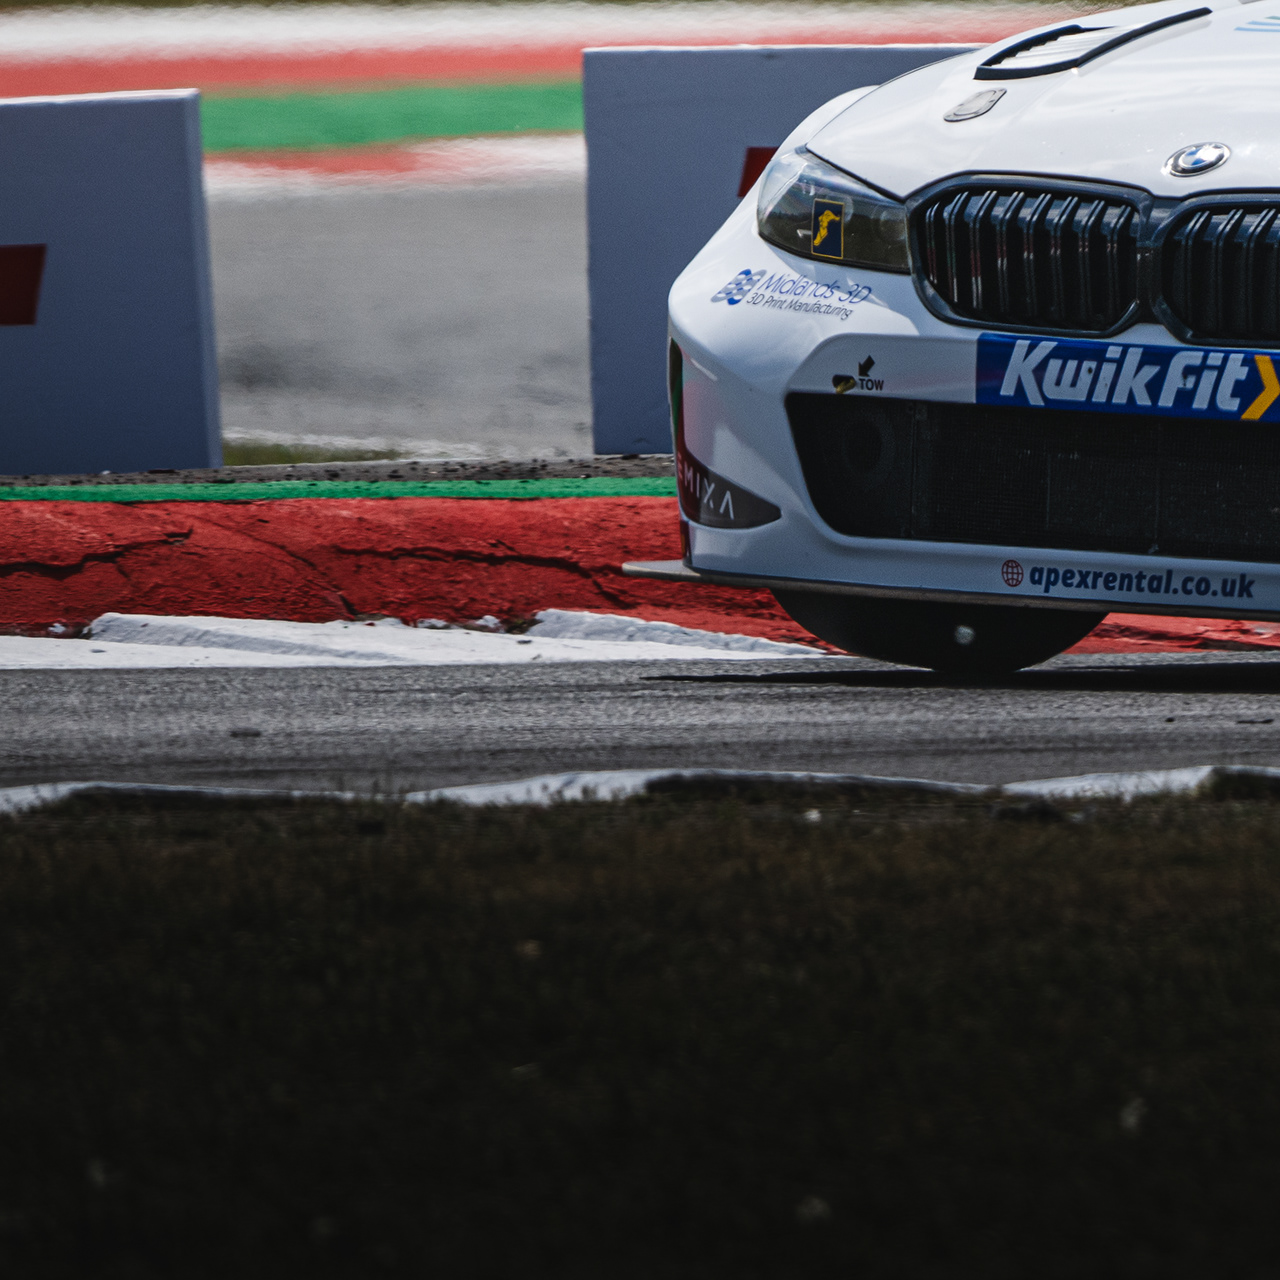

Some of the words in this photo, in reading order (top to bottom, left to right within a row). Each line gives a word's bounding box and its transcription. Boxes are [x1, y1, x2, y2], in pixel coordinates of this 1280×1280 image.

[757, 272, 840, 300] Midlands
[838, 283, 872, 304] 3D
[747, 292, 765, 305] 3D
[763, 295, 786, 310] Print
[785, 298, 855, 321] Manufacturing
[858, 378, 885, 391] TOW
[1028, 560, 1256, 599] apexrental.co.uk
